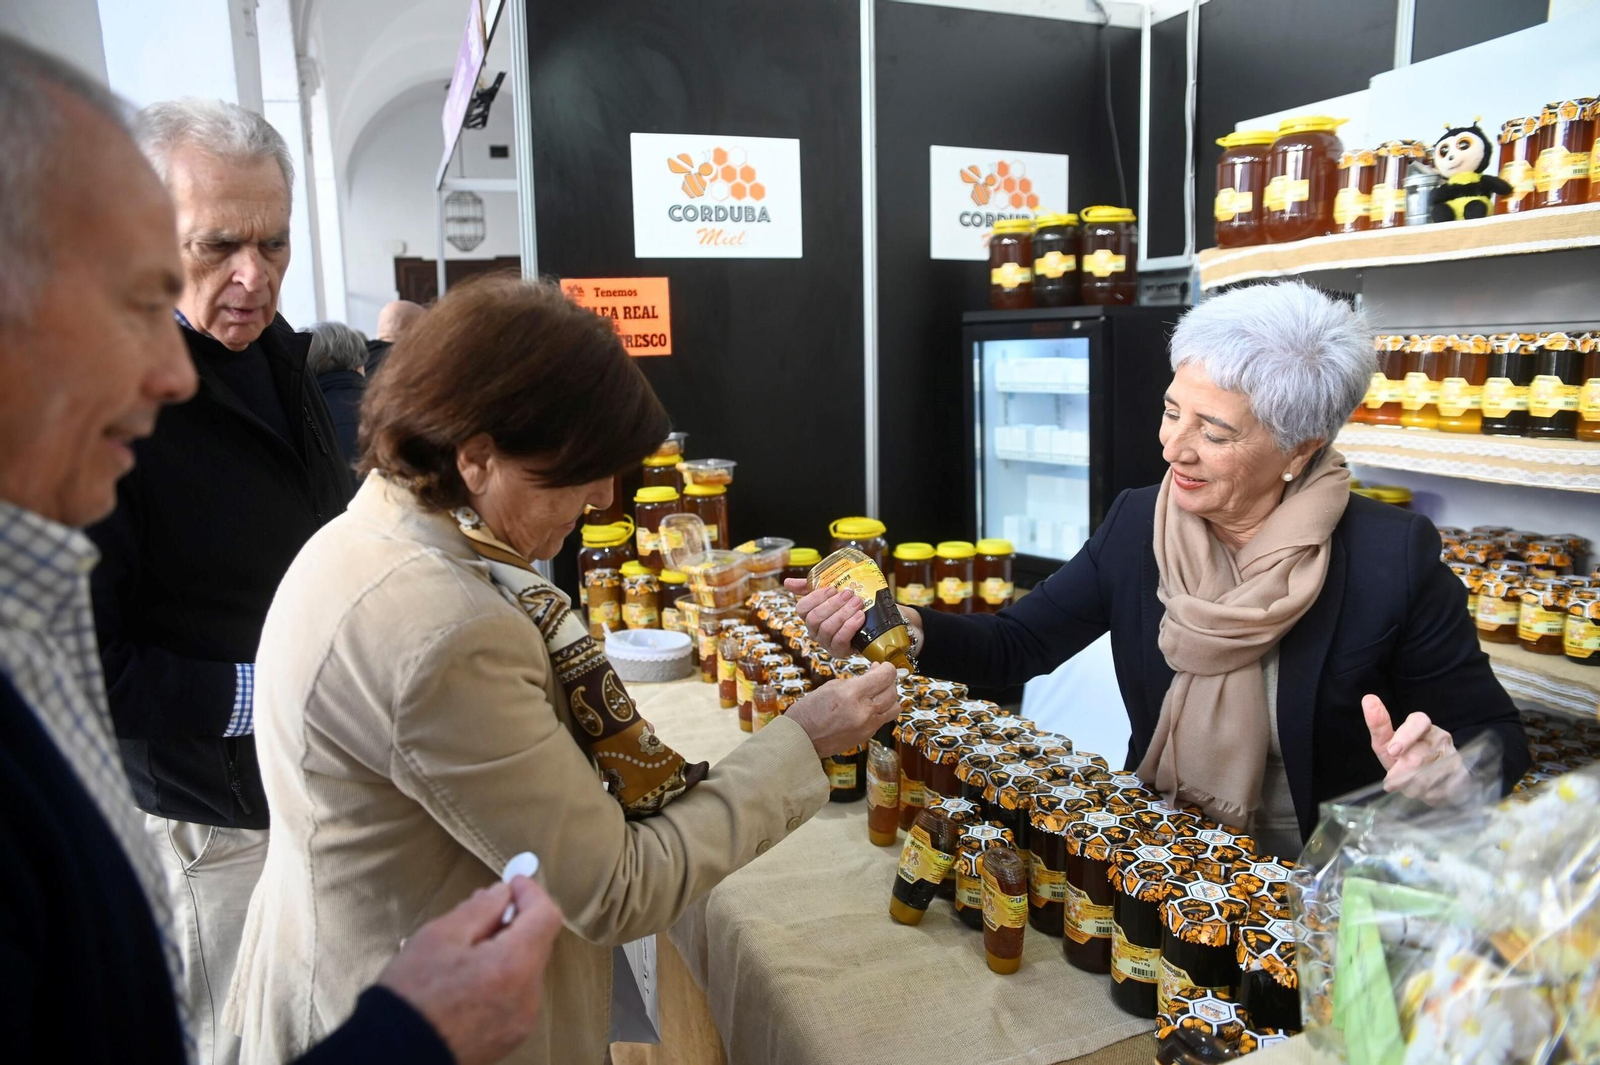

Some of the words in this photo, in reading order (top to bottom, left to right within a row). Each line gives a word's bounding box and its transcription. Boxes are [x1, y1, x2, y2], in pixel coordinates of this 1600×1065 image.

[668, 204, 772, 223] CORDUBA
[696, 227, 747, 246] Miel
[593, 287, 638, 297] Tenemos
[623, 305, 659, 319] REAL
